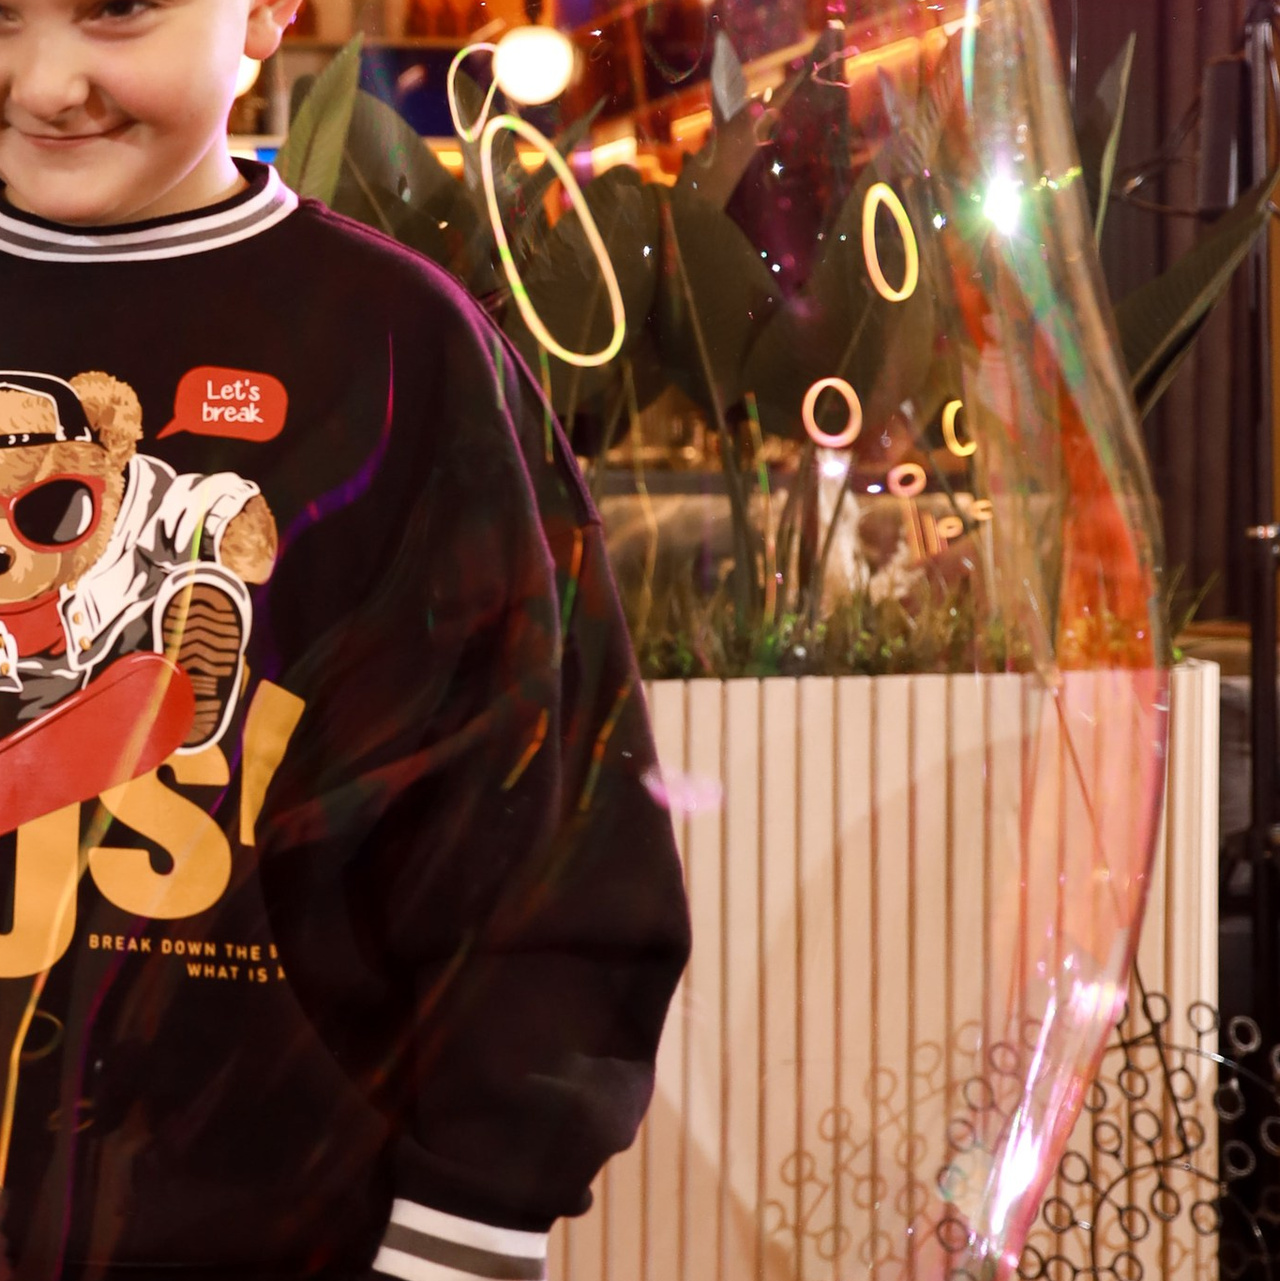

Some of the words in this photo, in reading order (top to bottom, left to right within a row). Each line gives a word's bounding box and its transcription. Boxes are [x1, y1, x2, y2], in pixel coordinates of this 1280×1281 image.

[206, 378, 261, 401] Let's
[202, 401, 264, 423] break
[89, 933, 151, 952] BREAK
[161, 938, 216, 957] DOWN
[226, 943, 261, 961] THE
[186, 962, 239, 980] WHAT
[248, 967, 268, 983] IS
